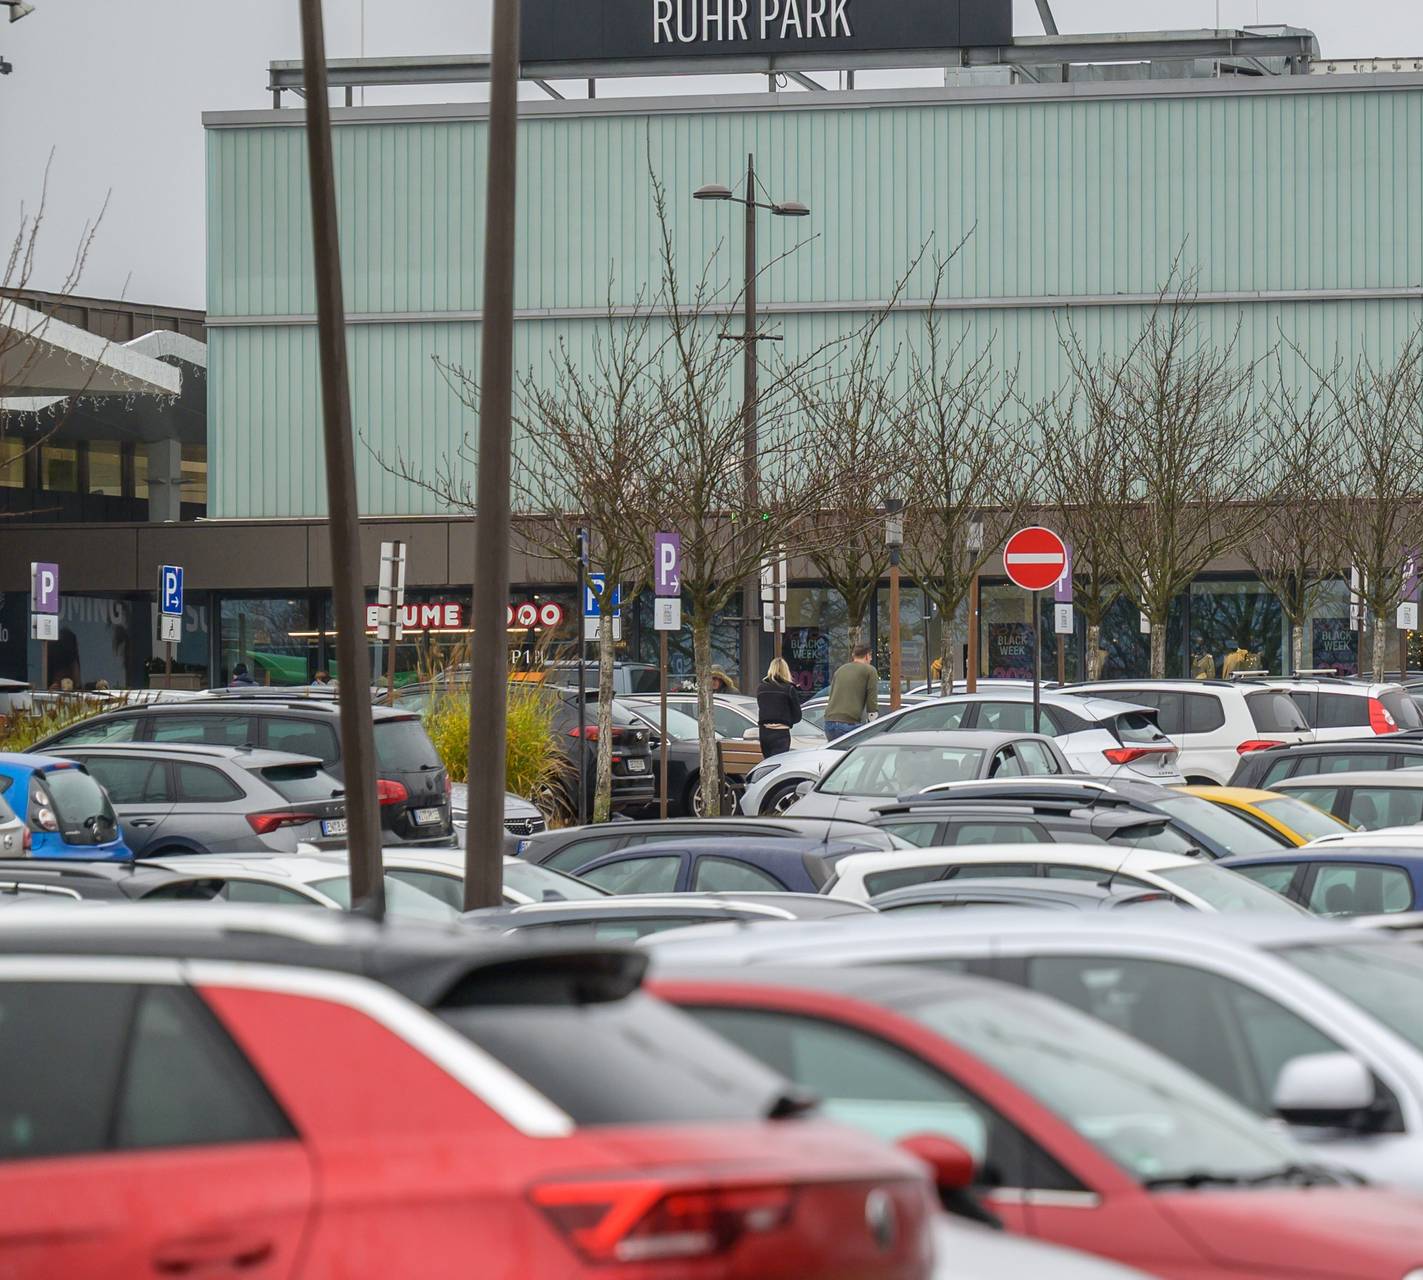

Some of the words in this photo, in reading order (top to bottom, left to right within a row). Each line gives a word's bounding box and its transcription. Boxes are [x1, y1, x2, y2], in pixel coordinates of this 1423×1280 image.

[760, 0, 851, 39] PARK
[661, 543, 676, 586] P
[41, 571, 54, 604] P
[166, 572, 178, 607] P
[998, 635, 1028, 646] BLACK
[1321, 631, 1352, 641] BLACK
[790, 639, 821, 649] BLACK
[1324, 641, 1350, 652] WEEK
[792, 649, 818, 659] WEEK
[1000, 645, 1026, 656] WEEK
[510, 649, 529, 664] P1
